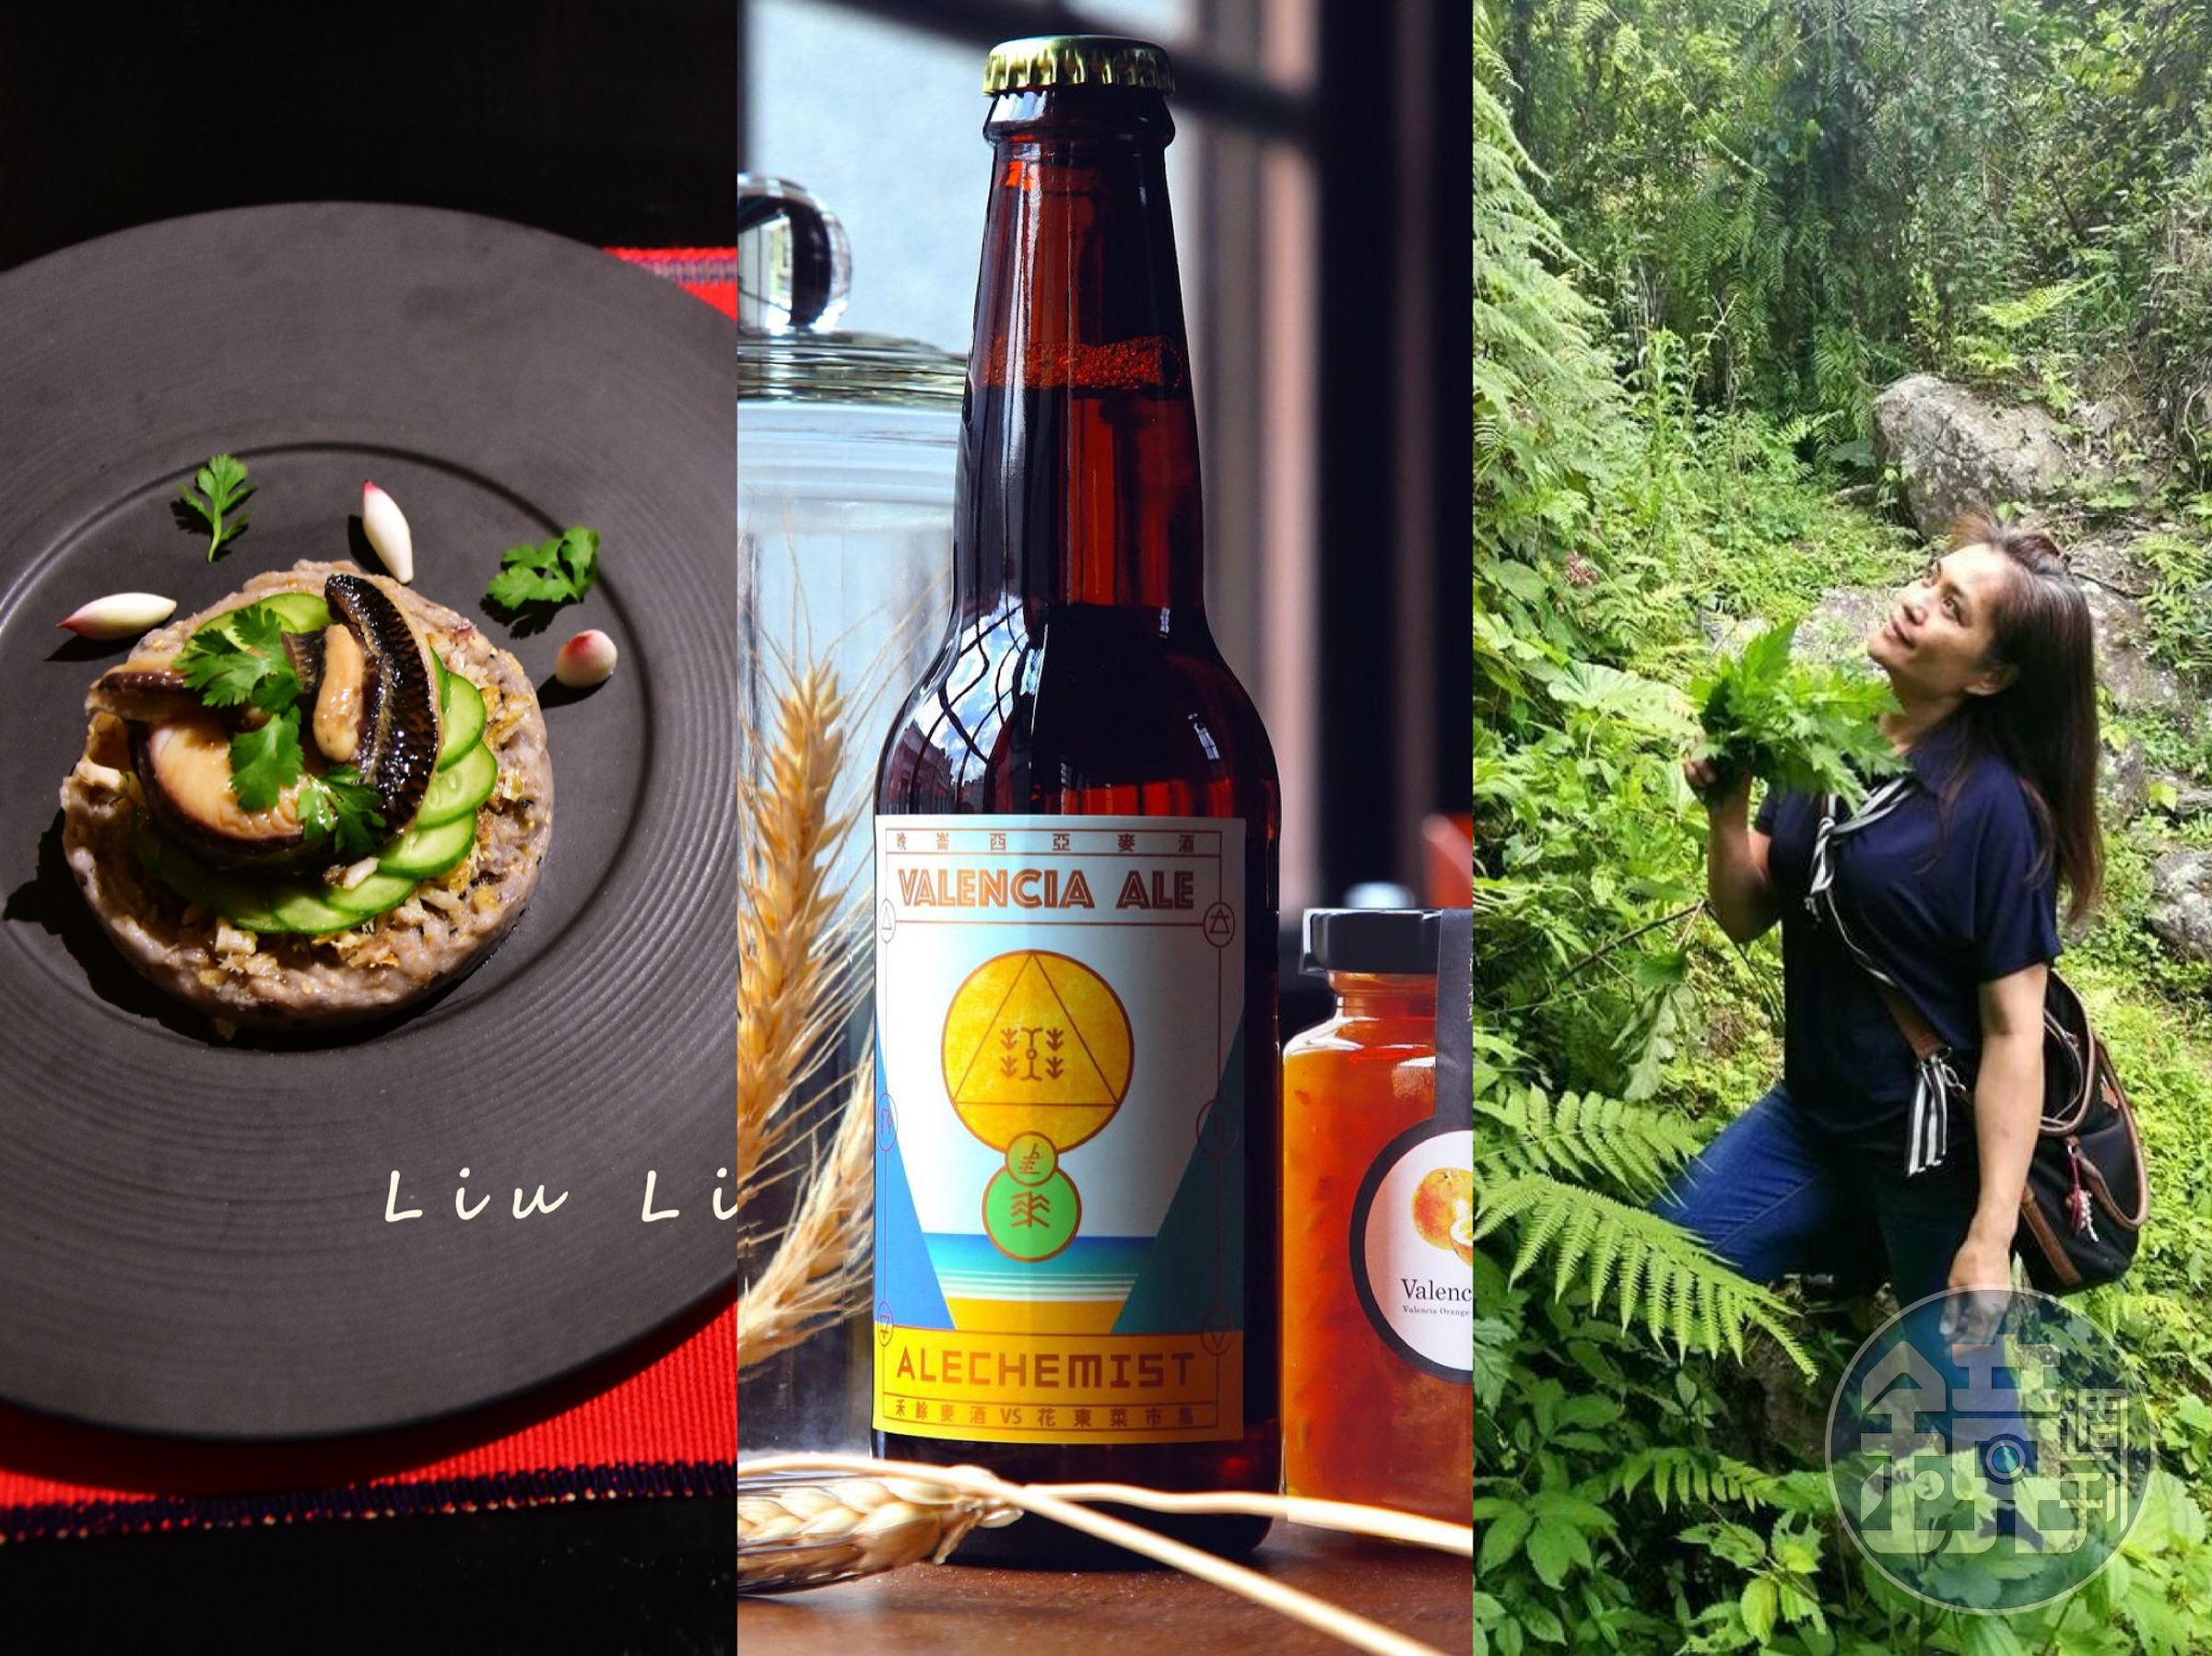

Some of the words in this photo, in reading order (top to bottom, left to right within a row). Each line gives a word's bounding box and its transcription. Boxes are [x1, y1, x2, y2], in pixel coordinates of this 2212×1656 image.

[897, 868, 1095, 909] VALENCIA
[1116, 870, 1194, 910] ALE
[1401, 1277, 1472, 1302] Valenc
[1403, 1304, 1438, 1314] Valencia
[1440, 1308, 1470, 1317] Orange
[896, 1345, 1194, 1389] ALECHEMIST
